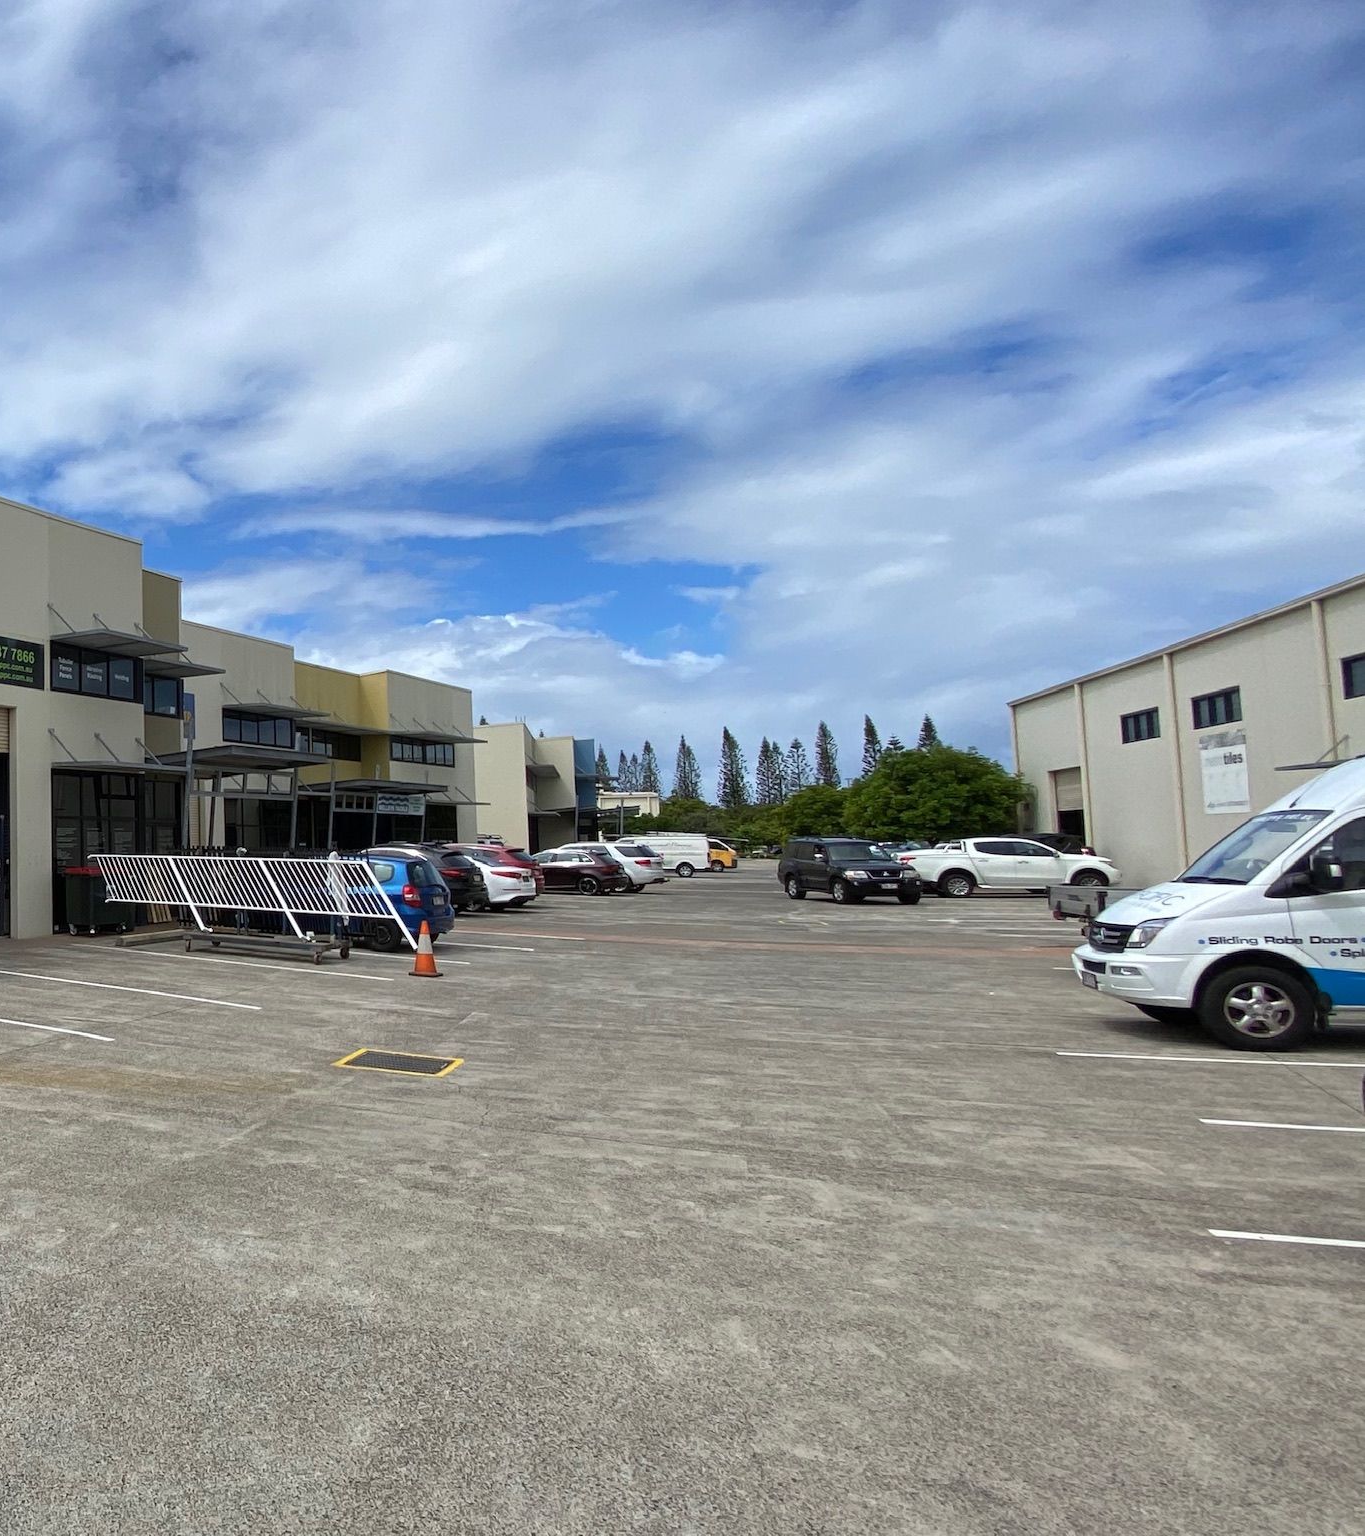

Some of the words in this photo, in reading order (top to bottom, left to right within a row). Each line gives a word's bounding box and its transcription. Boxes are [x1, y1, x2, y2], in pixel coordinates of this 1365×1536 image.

[10, 647, 35, 665] 7866
[1223, 752, 1243, 765] tiles
[1208, 936, 1259, 946] Sliding
[1264, 936, 1303, 945] Robe
[1309, 936, 1358, 944] Doors
